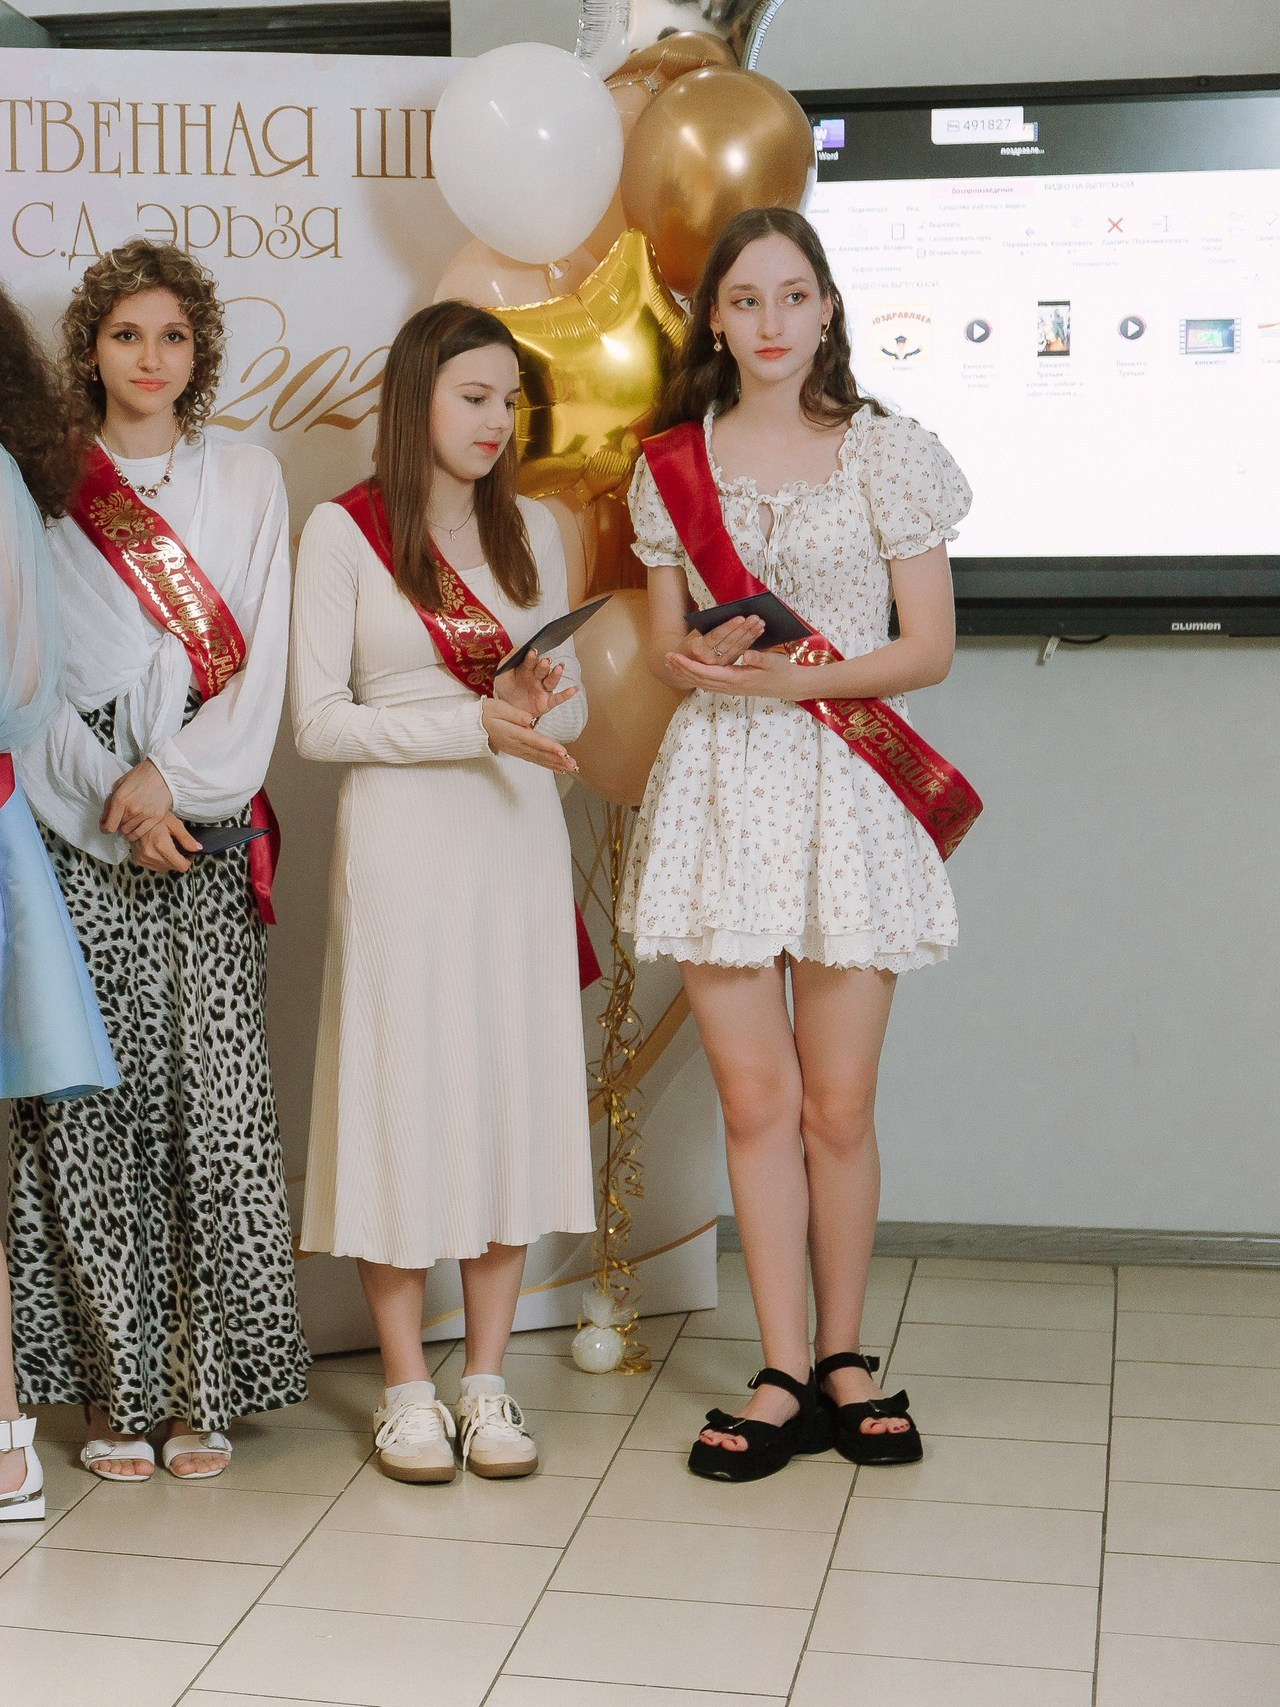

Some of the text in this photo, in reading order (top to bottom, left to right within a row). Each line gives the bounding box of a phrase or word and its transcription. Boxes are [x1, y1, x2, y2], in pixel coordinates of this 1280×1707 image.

[963, 118, 1012, 131] 491827
[818, 150, 839, 161] Word
[204, 345, 393, 433] 202
